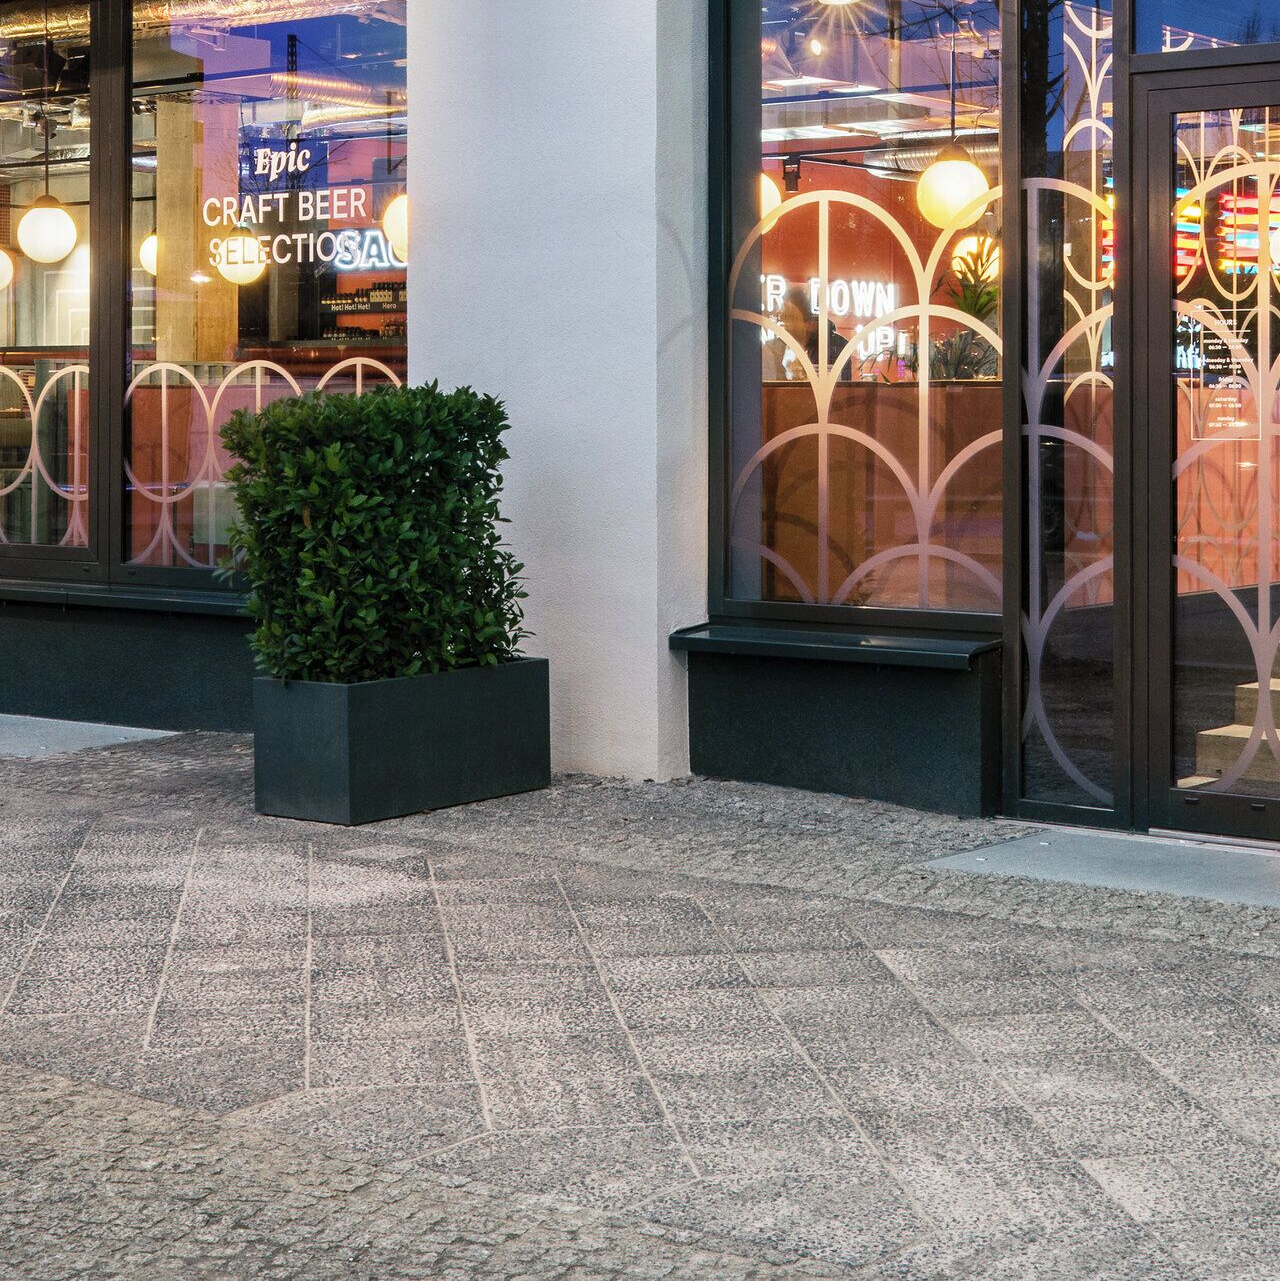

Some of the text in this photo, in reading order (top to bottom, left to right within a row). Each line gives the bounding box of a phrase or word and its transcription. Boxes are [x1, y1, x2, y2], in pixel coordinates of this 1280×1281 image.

[254, 142, 311, 182] Epic
[202, 187, 367, 227] CRAFT BEER
[810, 277, 895, 318] DOWN
